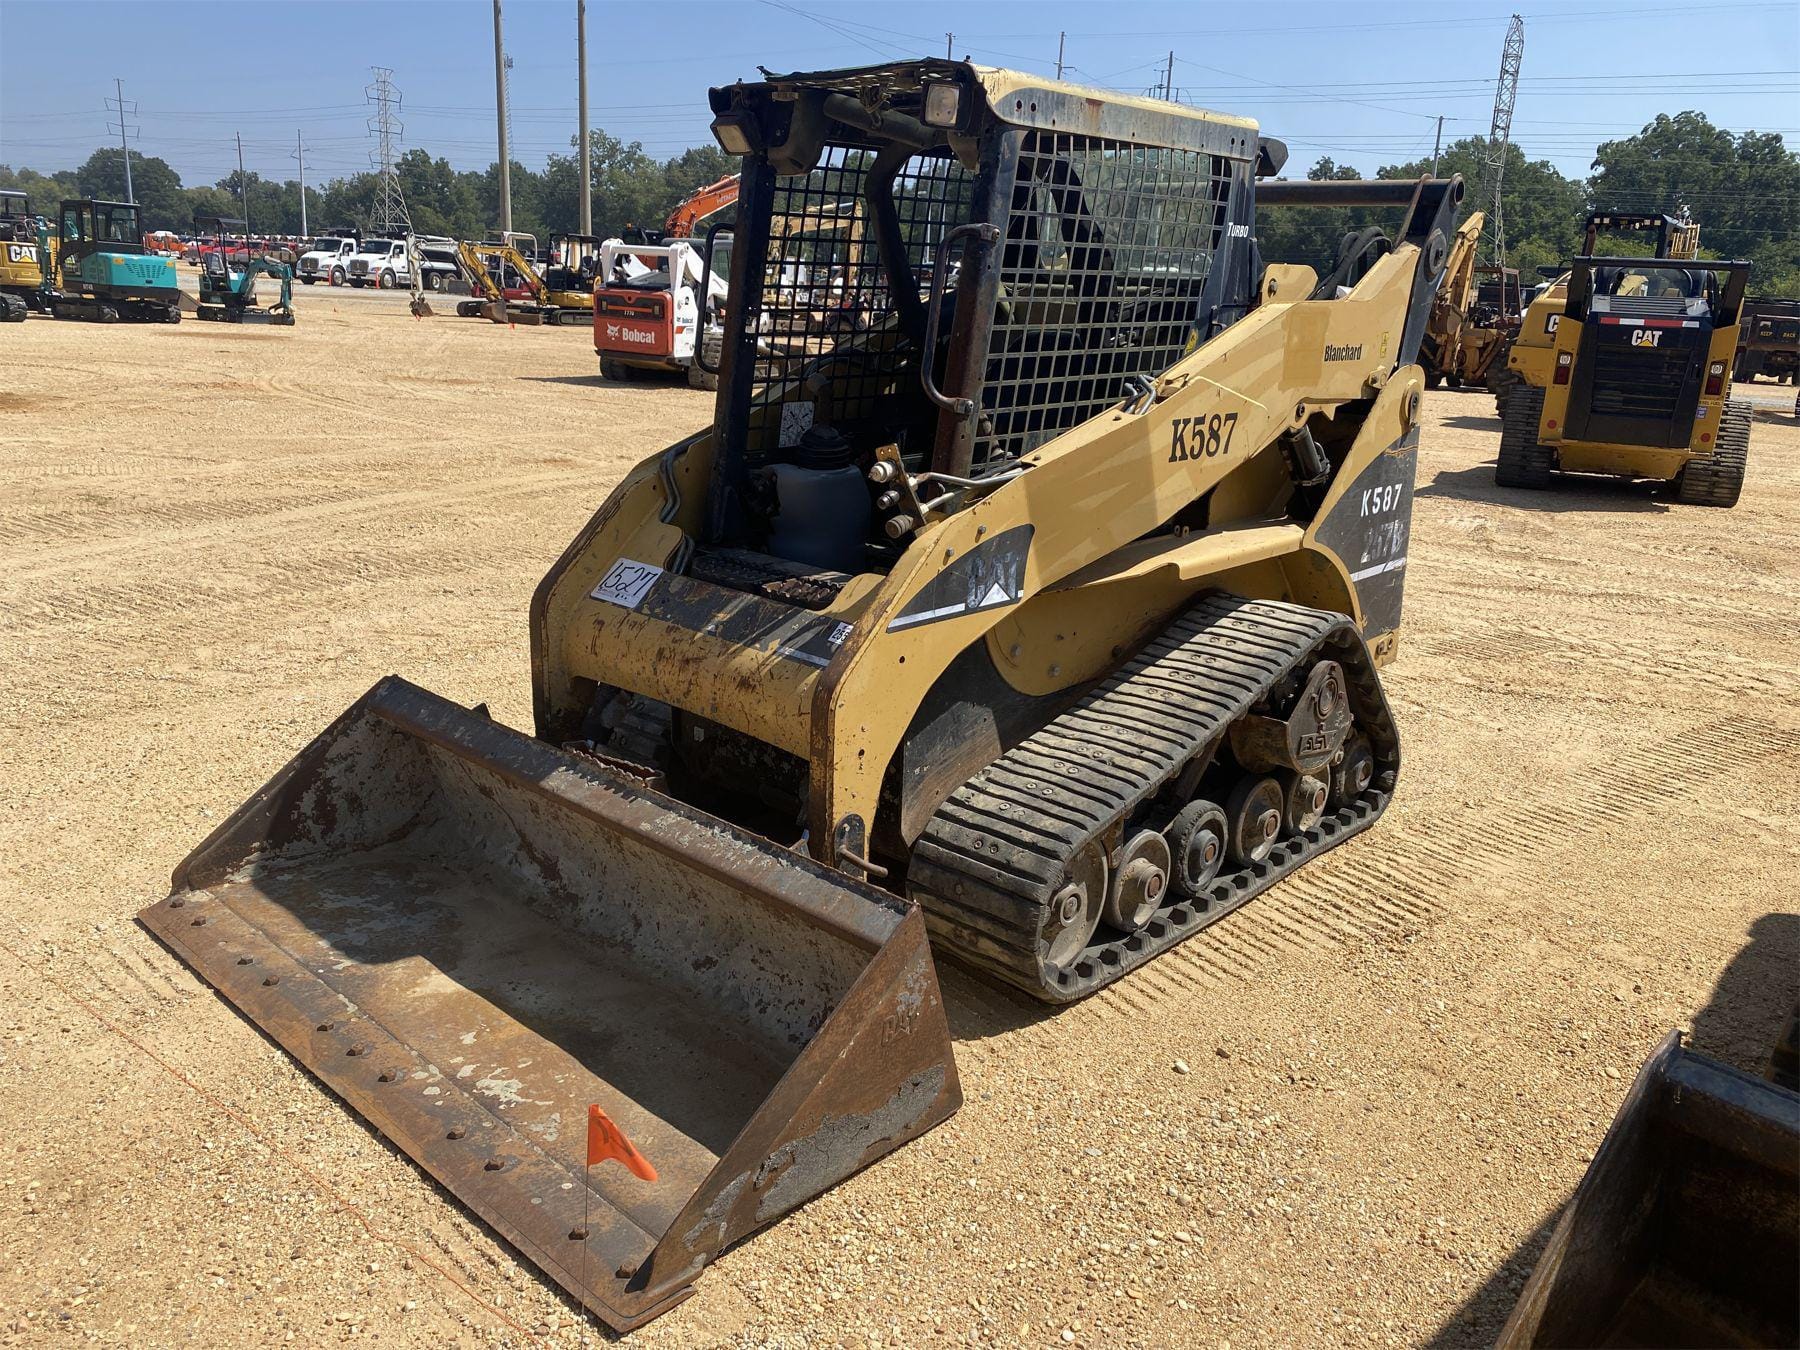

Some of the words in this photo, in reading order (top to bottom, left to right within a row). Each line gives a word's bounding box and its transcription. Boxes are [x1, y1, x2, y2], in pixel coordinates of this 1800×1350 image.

[1227, 222, 1249, 237] TURBO
[9, 245, 37, 263] CAT
[622, 327, 655, 344] Bobcat
[1631, 329, 1662, 347] CAT
[1324, 343, 1363, 362] Blanchard
[1168, 412, 1239, 463] K587
[1360, 483, 1402, 518] K587
